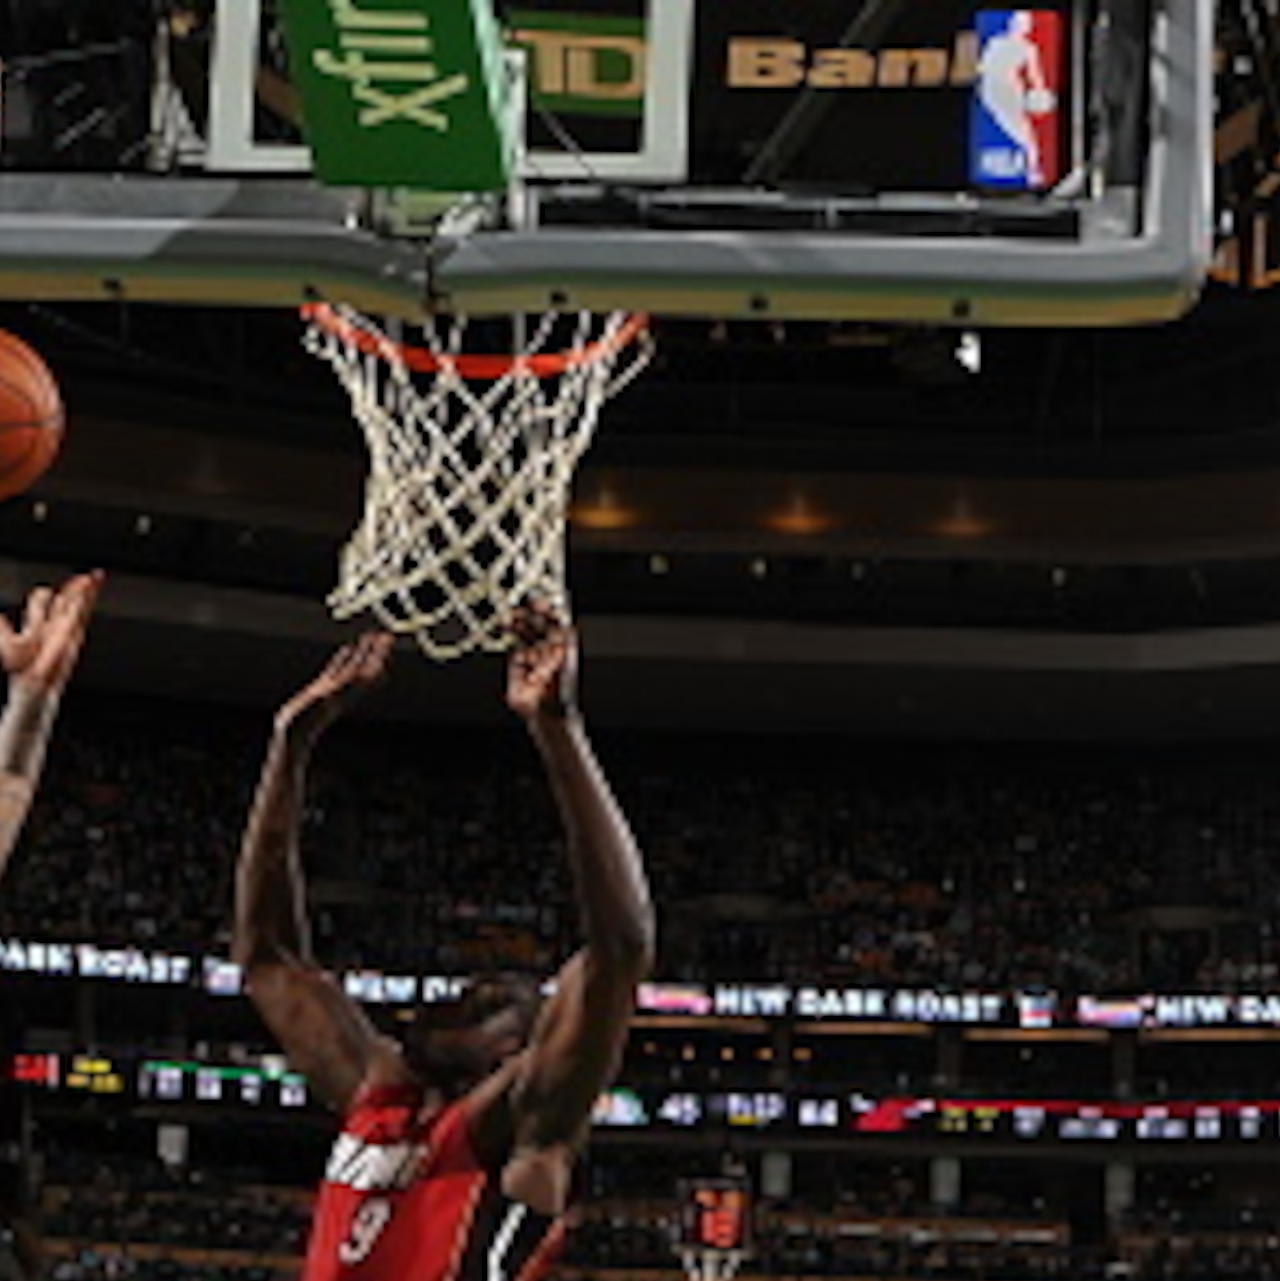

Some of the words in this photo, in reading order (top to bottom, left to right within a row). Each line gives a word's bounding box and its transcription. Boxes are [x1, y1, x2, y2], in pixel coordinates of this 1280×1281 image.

[507, 29, 645, 98] TD
[78, 946, 190, 982] ROAST
[714, 982, 791, 1016] NEW
[1156, 994, 1229, 1026] NEW
